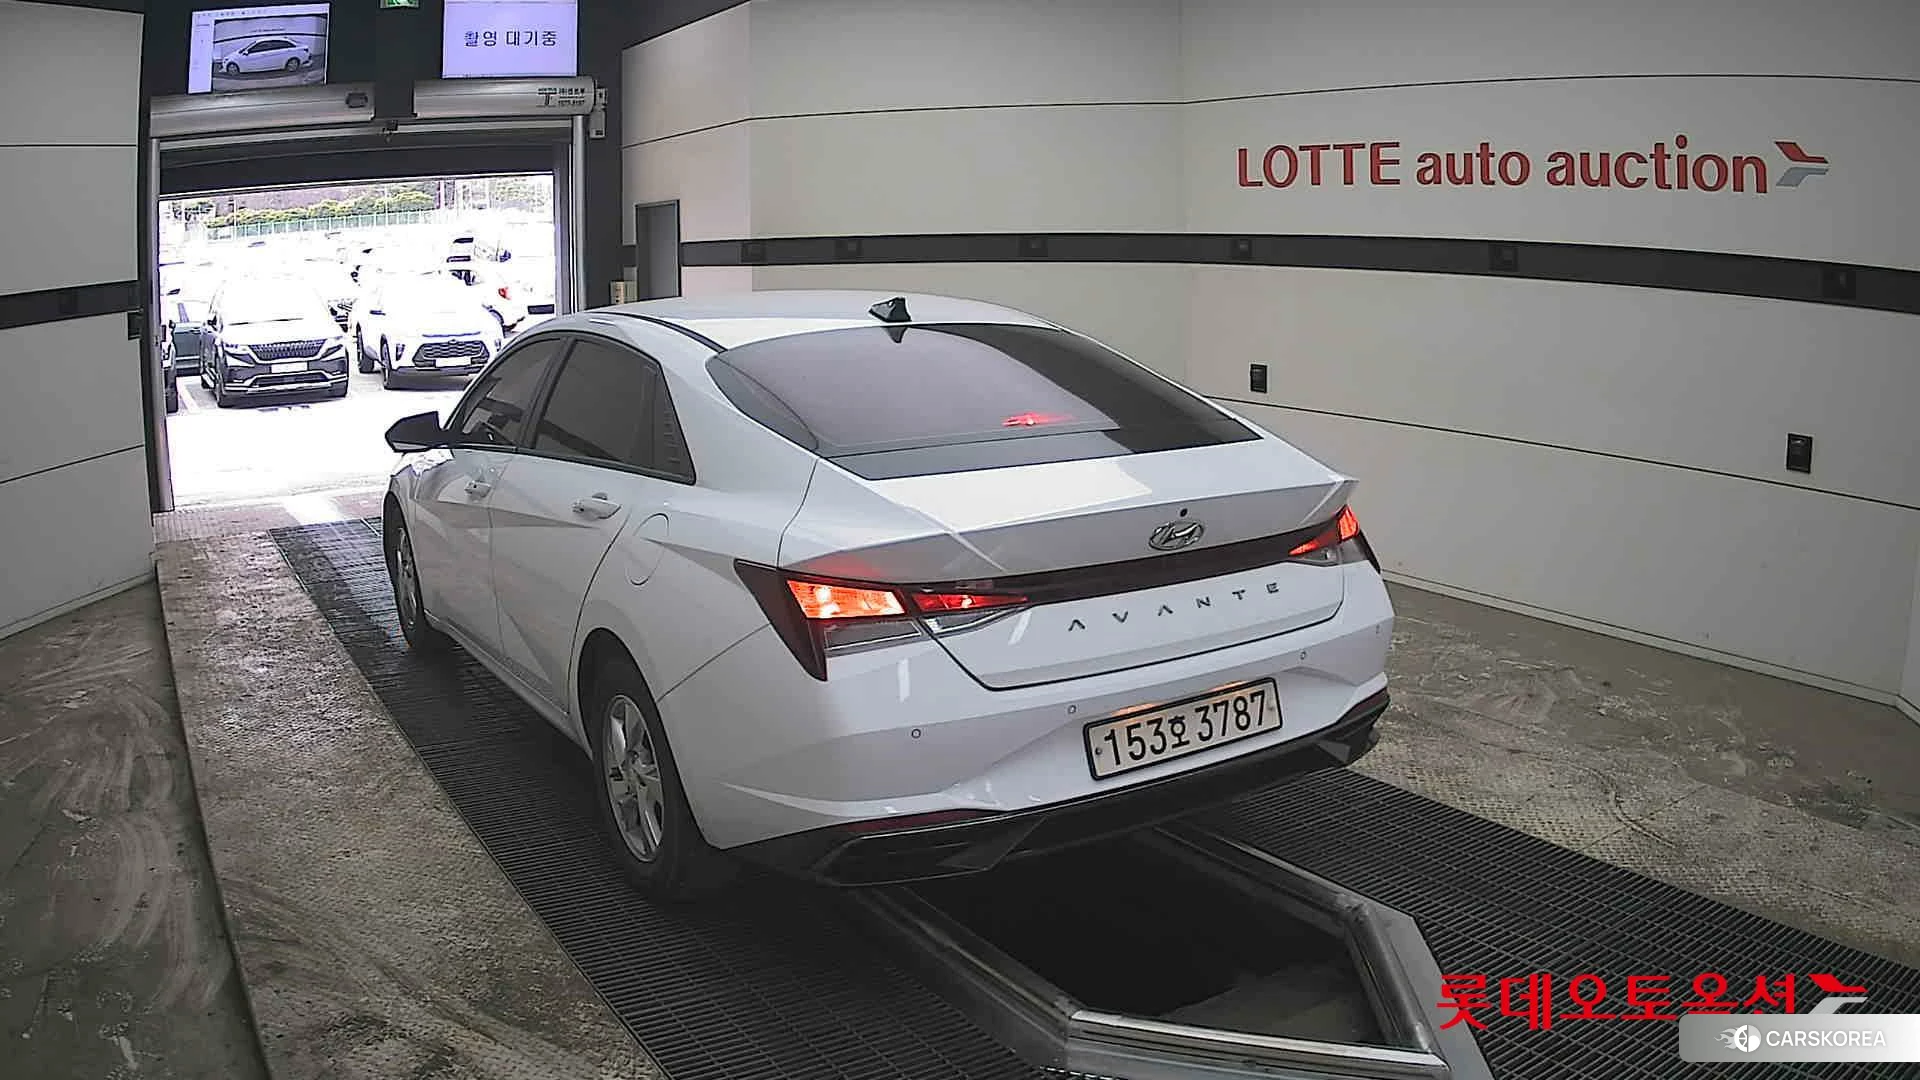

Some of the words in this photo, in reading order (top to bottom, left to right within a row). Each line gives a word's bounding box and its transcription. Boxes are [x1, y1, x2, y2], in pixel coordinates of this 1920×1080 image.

[506, 30, 557, 47] 대기중
[1237, 141, 1401, 187] LOTTE
[1415, 141, 1531, 186] auto
[1545, 134, 1768, 194] auction
[1067, 582, 1280, 632] AVANTE
[1195, 690, 1266, 742] 3787
